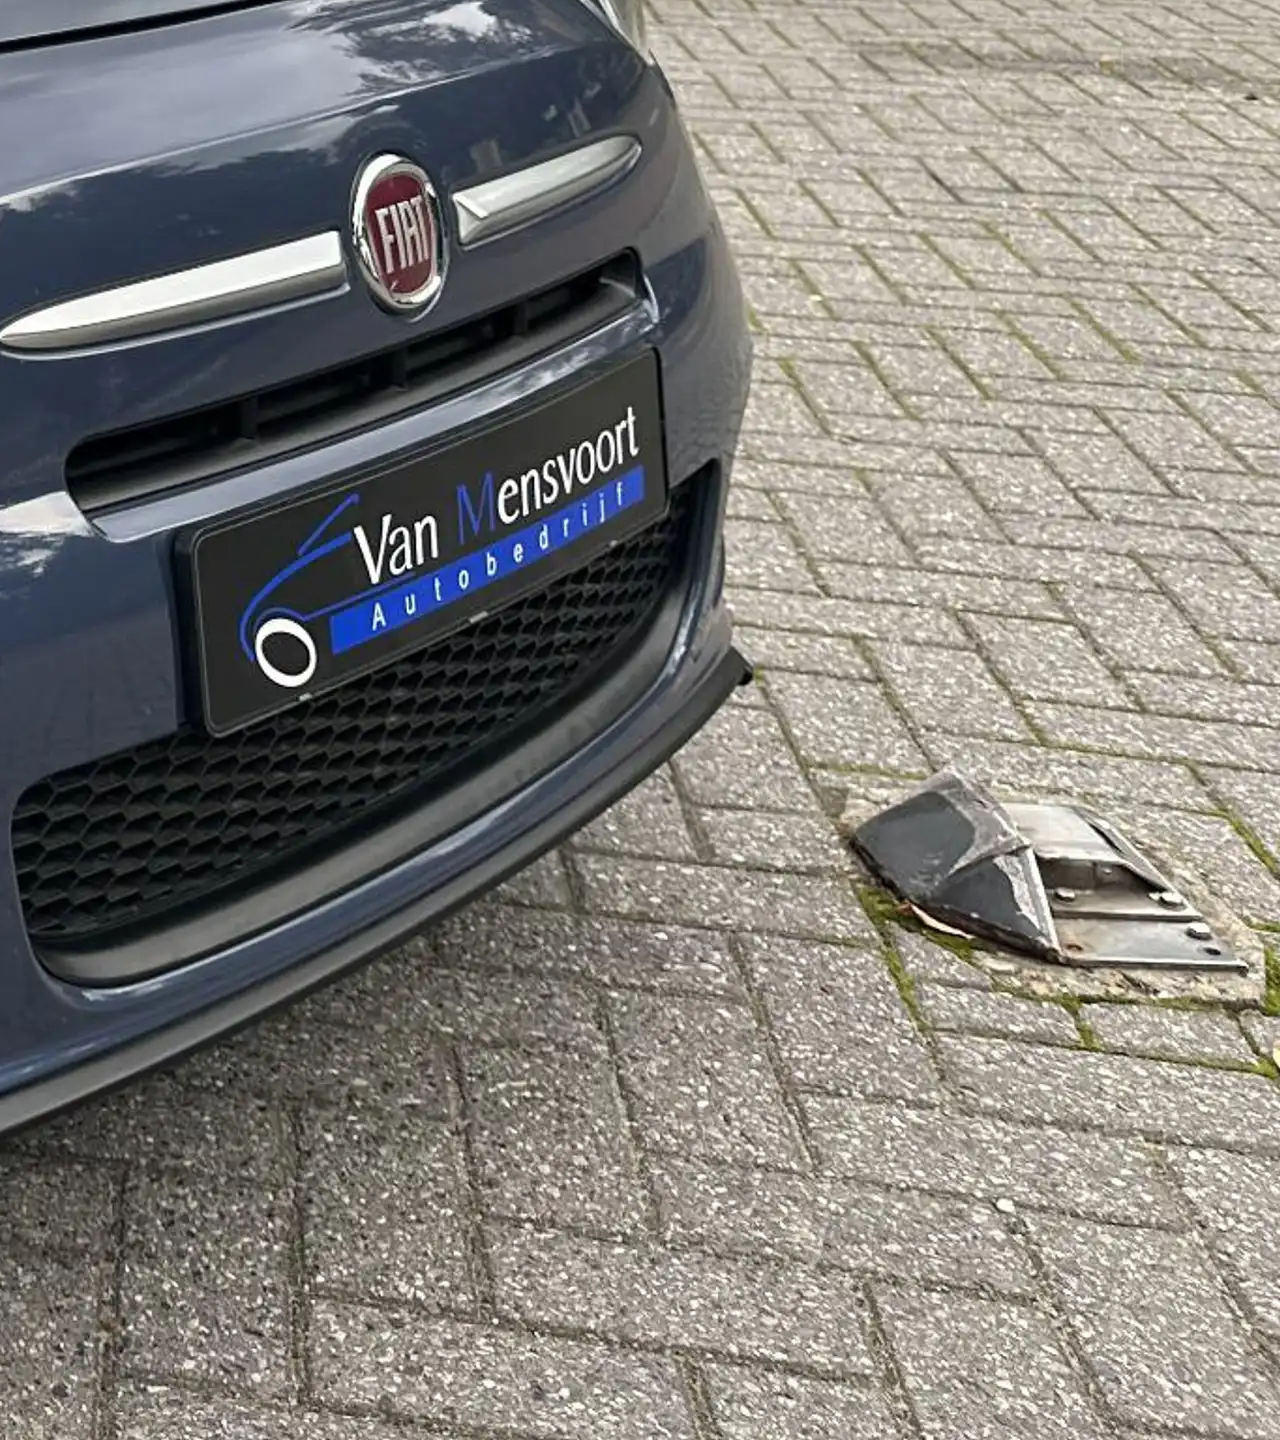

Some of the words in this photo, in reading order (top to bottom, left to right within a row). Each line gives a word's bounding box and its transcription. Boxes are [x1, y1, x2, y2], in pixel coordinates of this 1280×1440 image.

[375, 195, 430, 274] FIAT
[354, 513, 438, 584] Van
[456, 406, 639, 545] Mensvoort
[371, 481, 624, 631] Autobedrijf
